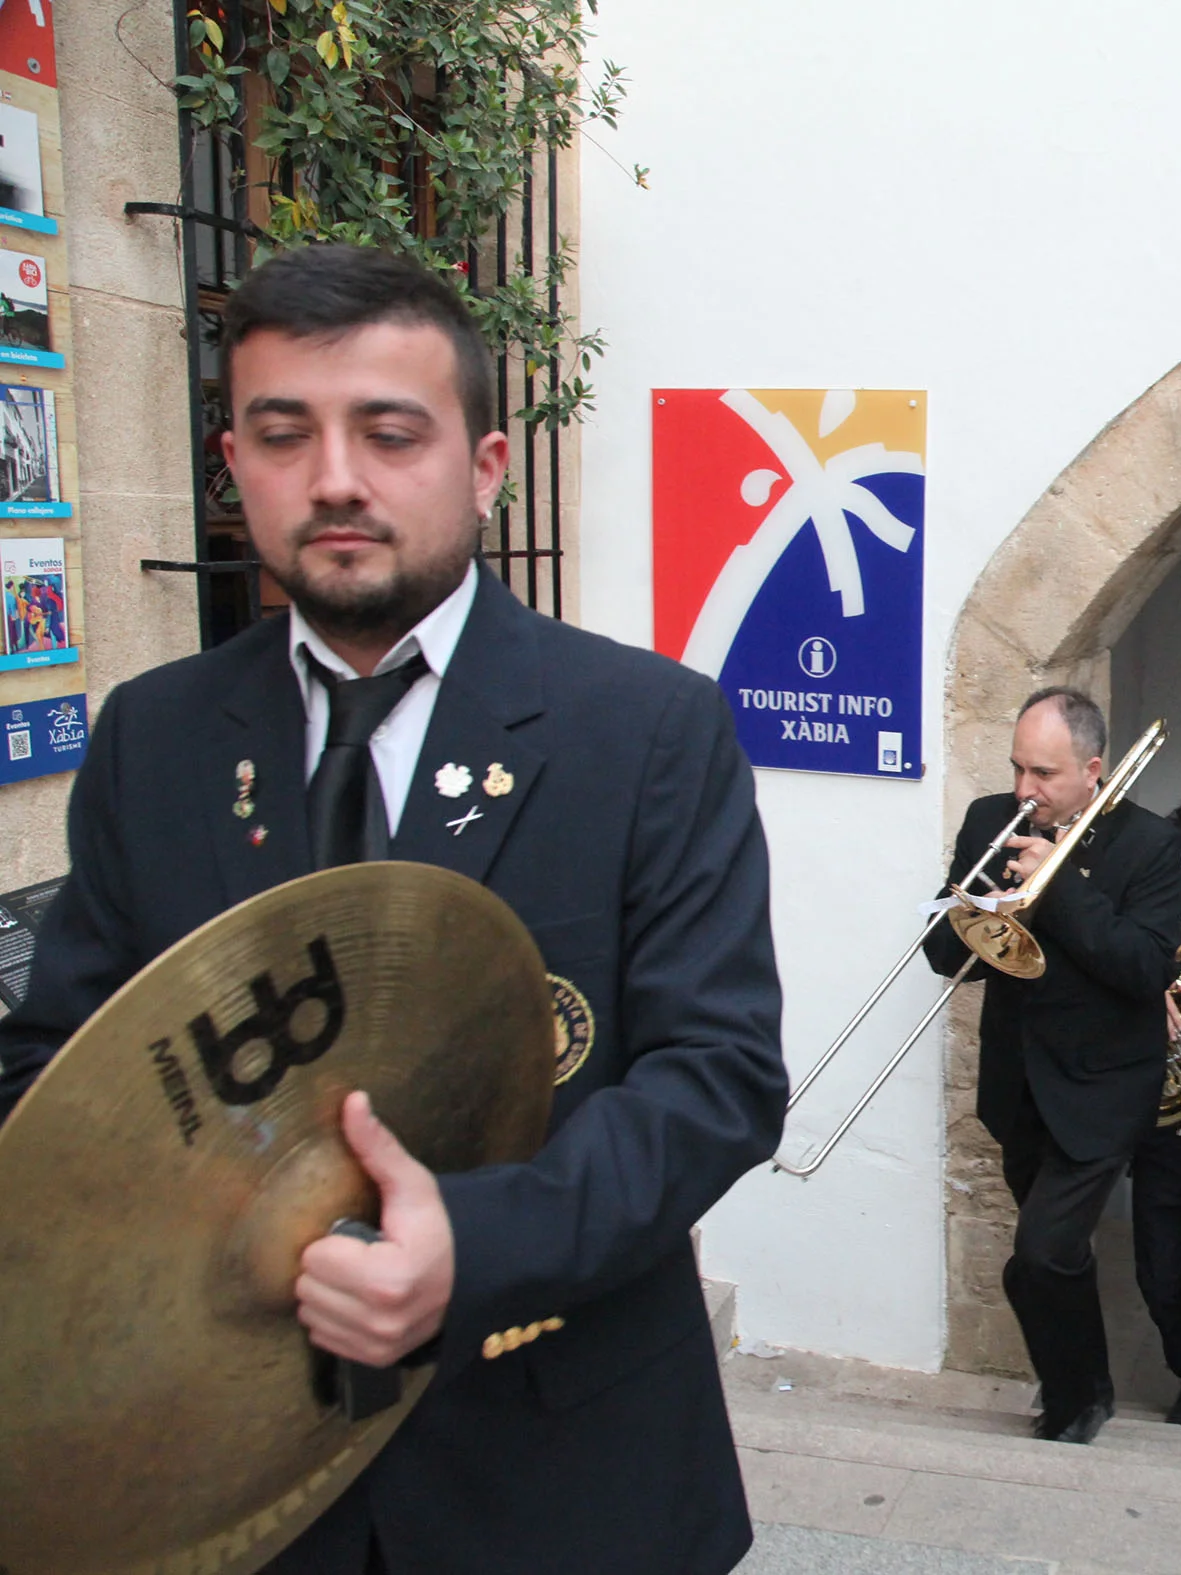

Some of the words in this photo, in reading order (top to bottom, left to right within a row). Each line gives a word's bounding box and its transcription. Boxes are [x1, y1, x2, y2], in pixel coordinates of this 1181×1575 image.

[8, 506, 26, 514] Plano
[28, 506, 54, 515] callejero
[29, 558, 62, 567] Eventos
[26, 656, 50, 664] Eventos
[738, 688, 832, 714] TOURIST
[838, 694, 893, 718] INFO
[6, 721, 30, 730] Eventos
[780, 715, 850, 745] XÀBIA
[49, 728, 85, 745] Xàbia
[53, 742, 82, 753] TURISME
[149, 1037, 203, 1147] MEINL
